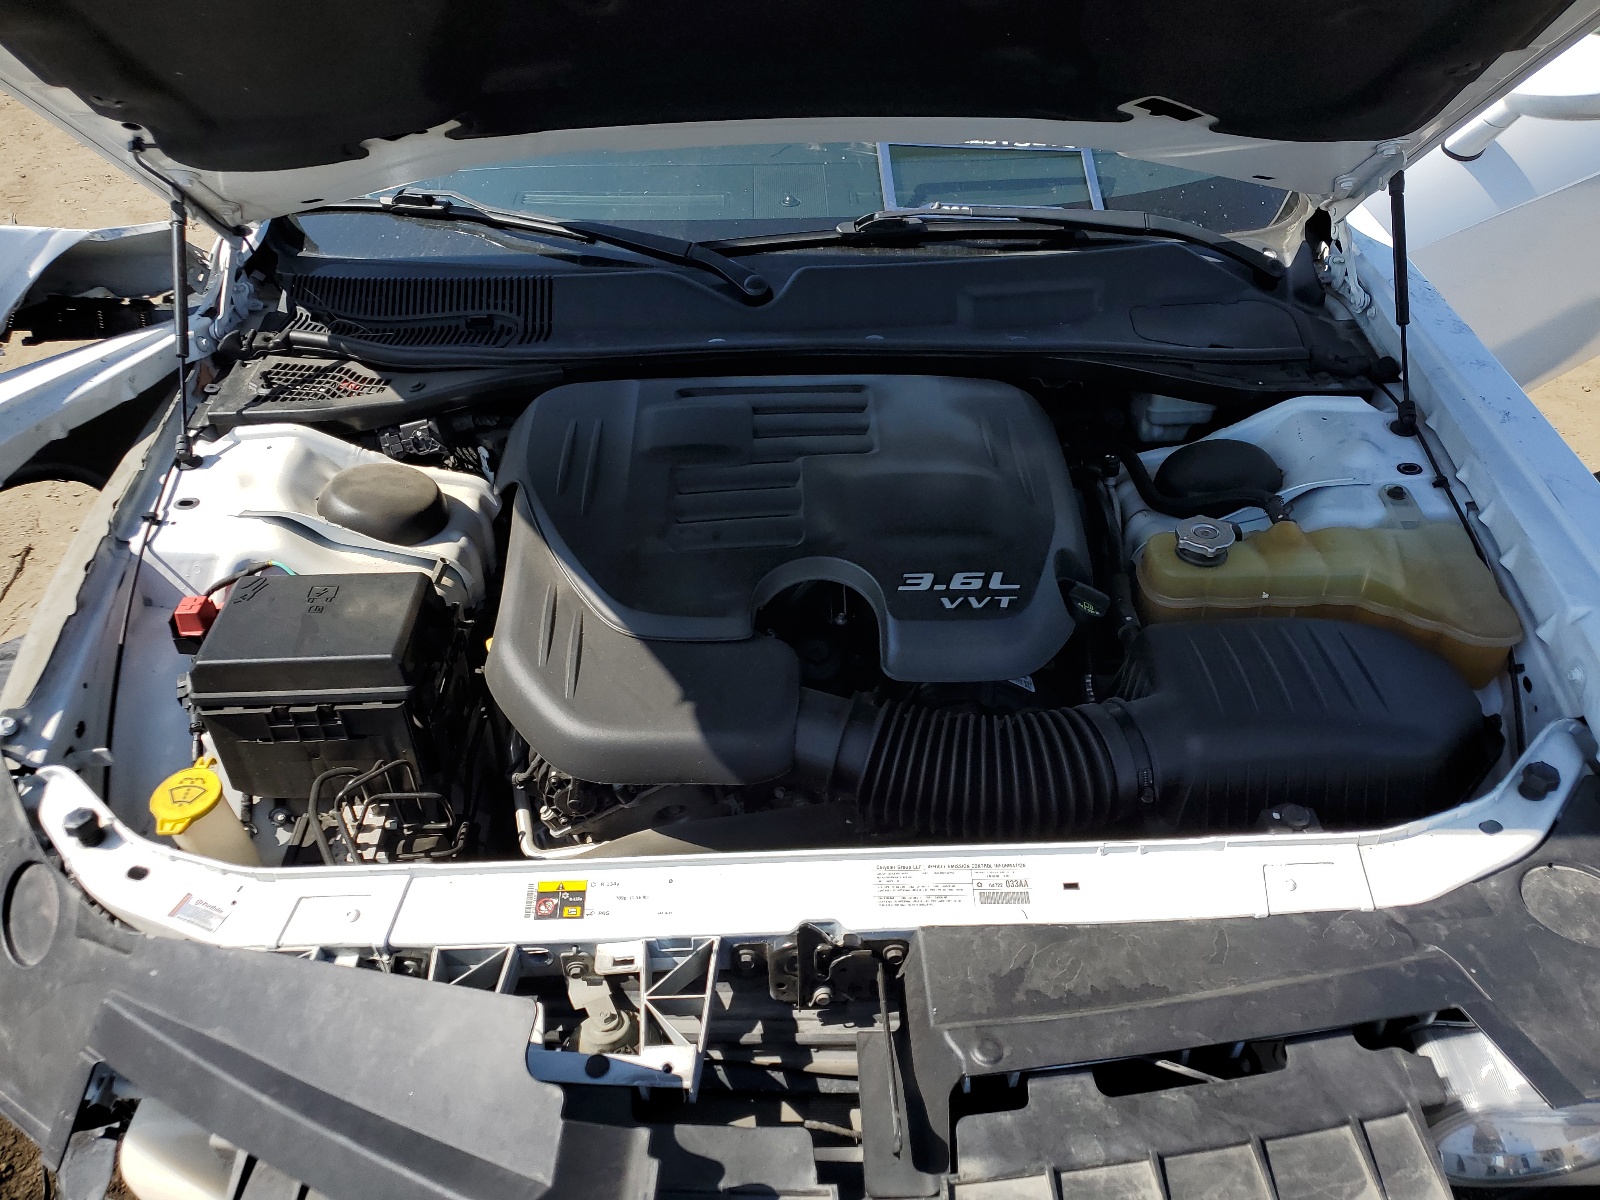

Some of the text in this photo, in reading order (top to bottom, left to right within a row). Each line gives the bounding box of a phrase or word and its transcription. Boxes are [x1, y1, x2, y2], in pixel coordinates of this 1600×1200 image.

[897, 571, 1021, 591] 3.6L
[940, 596, 1018, 609] VVT
[1005, 879, 1029, 889] 033AA
